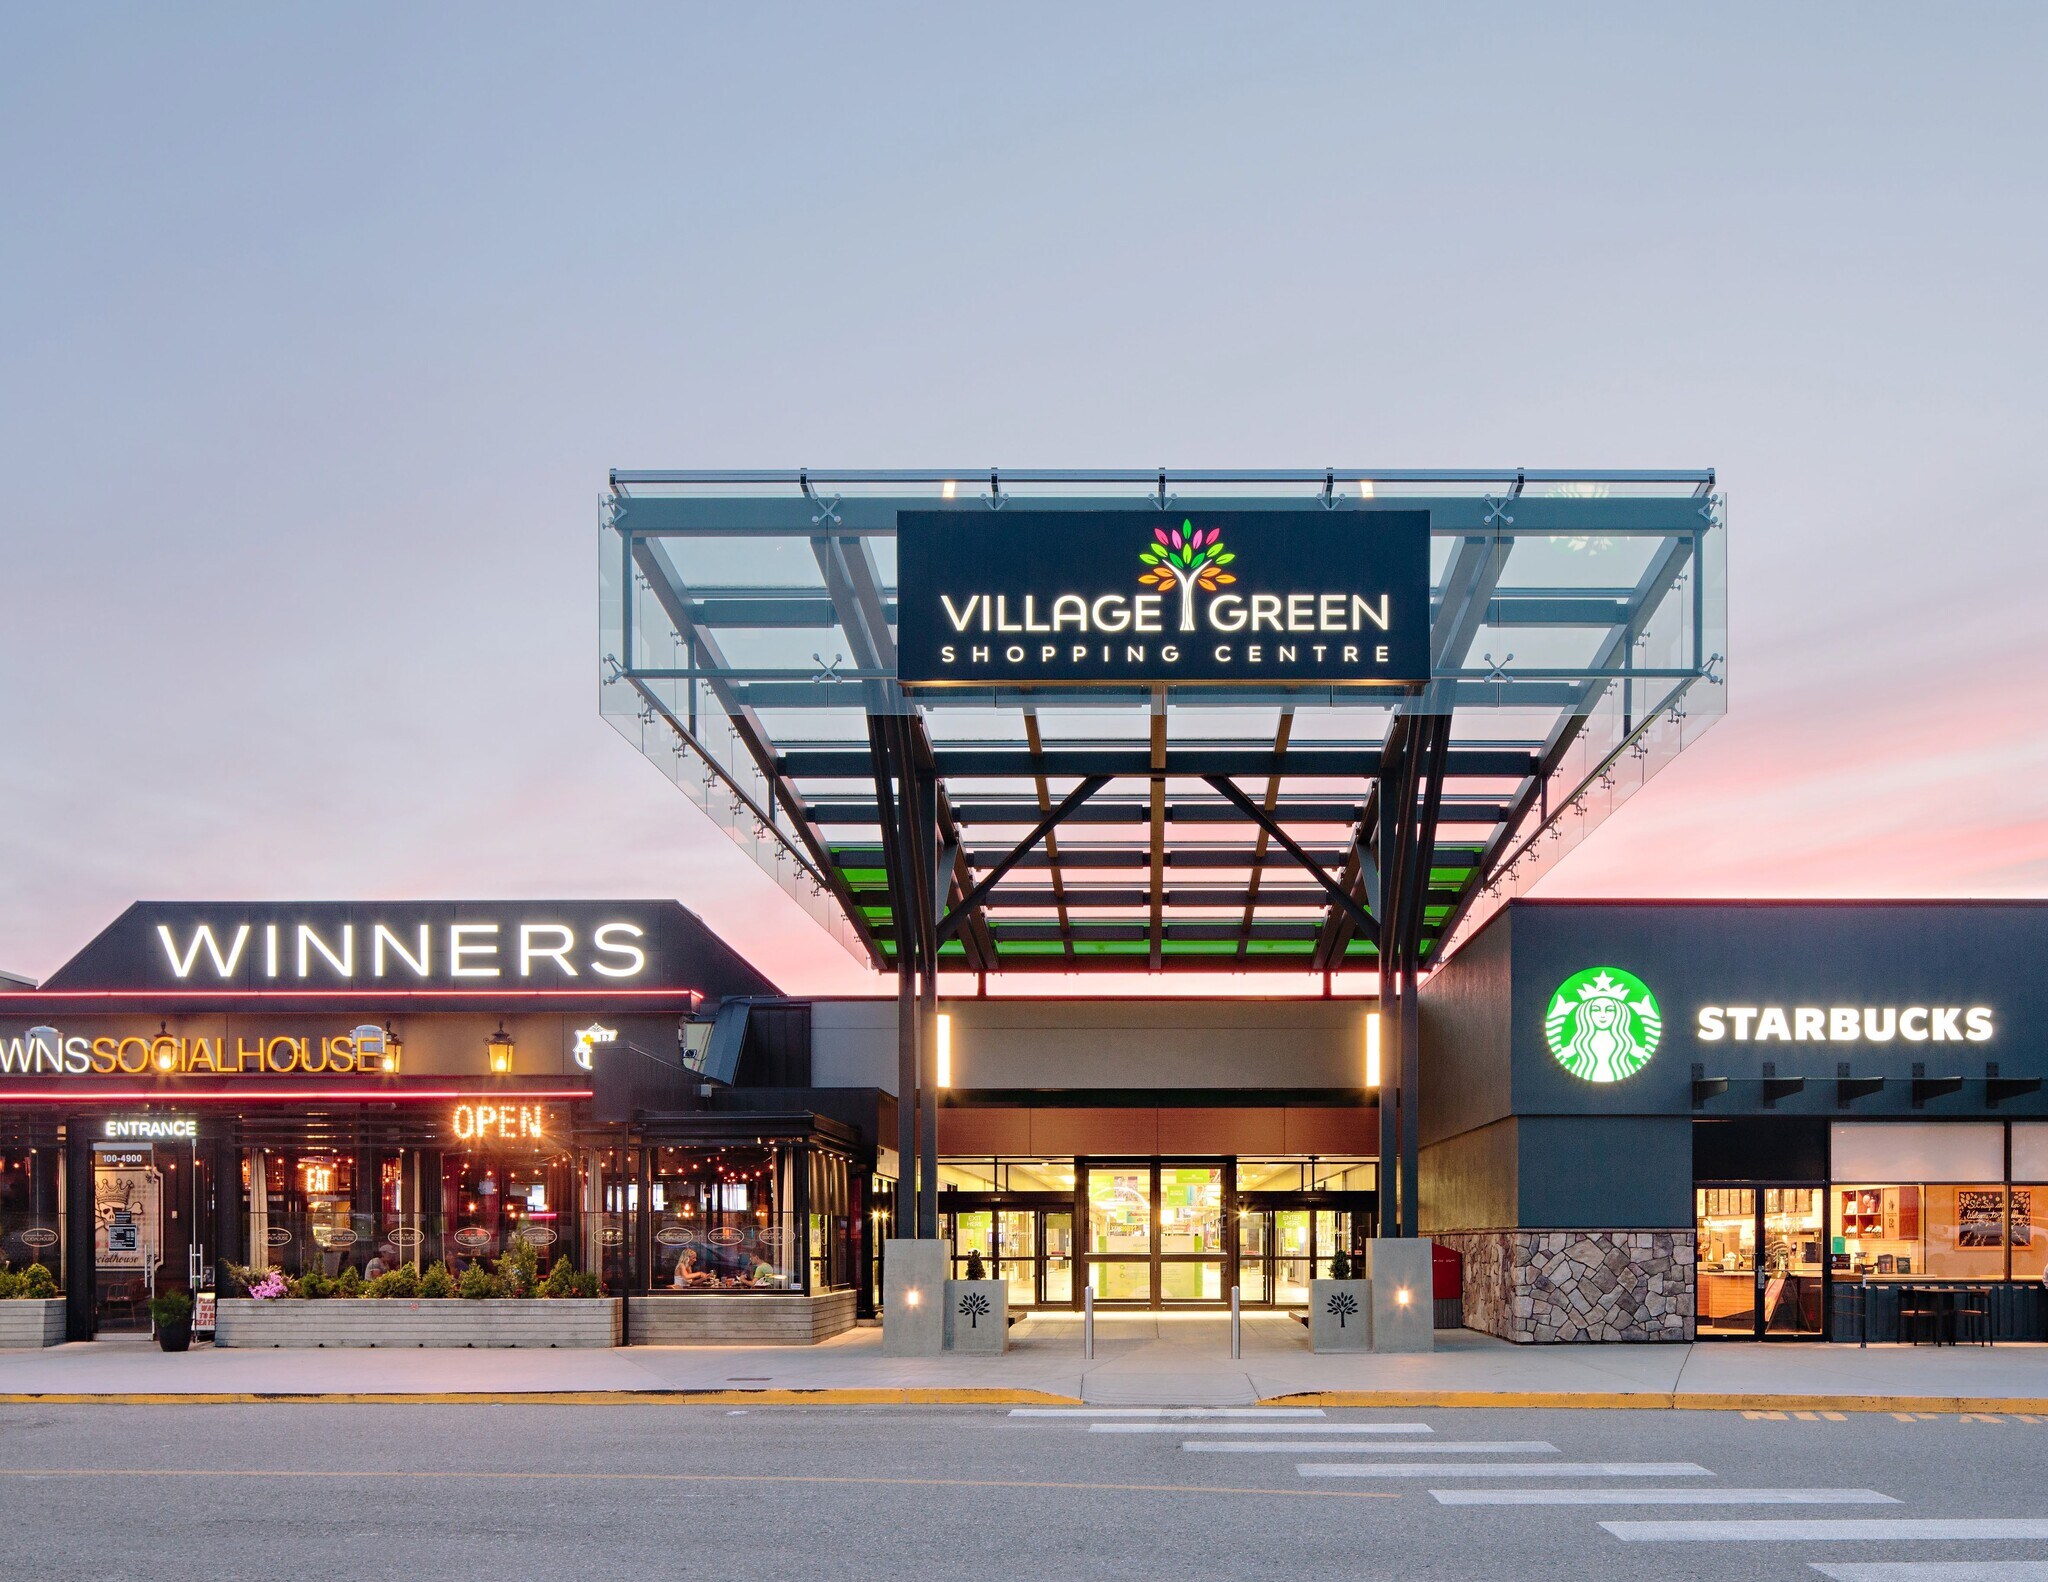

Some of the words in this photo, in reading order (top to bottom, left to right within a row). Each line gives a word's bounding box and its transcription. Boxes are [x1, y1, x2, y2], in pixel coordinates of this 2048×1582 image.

[940, 594, 1162, 632] VILLAGE
[1208, 593, 1390, 632] GREEN
[941, 645, 1180, 663] SHOPPING
[1214, 645, 1390, 663] CENTRE
[157, 923, 645, 978] WINNERS
[1697, 1006, 1994, 1042] STARBUCKS
[105, 1121, 197, 1136] ENTRANCE
[452, 1104, 542, 1139] OPEN
[102, 1154, 142, 1163] 100-4900
[307, 1168, 331, 1193] EAT
[95, 1252, 139, 1264] cialhouse
